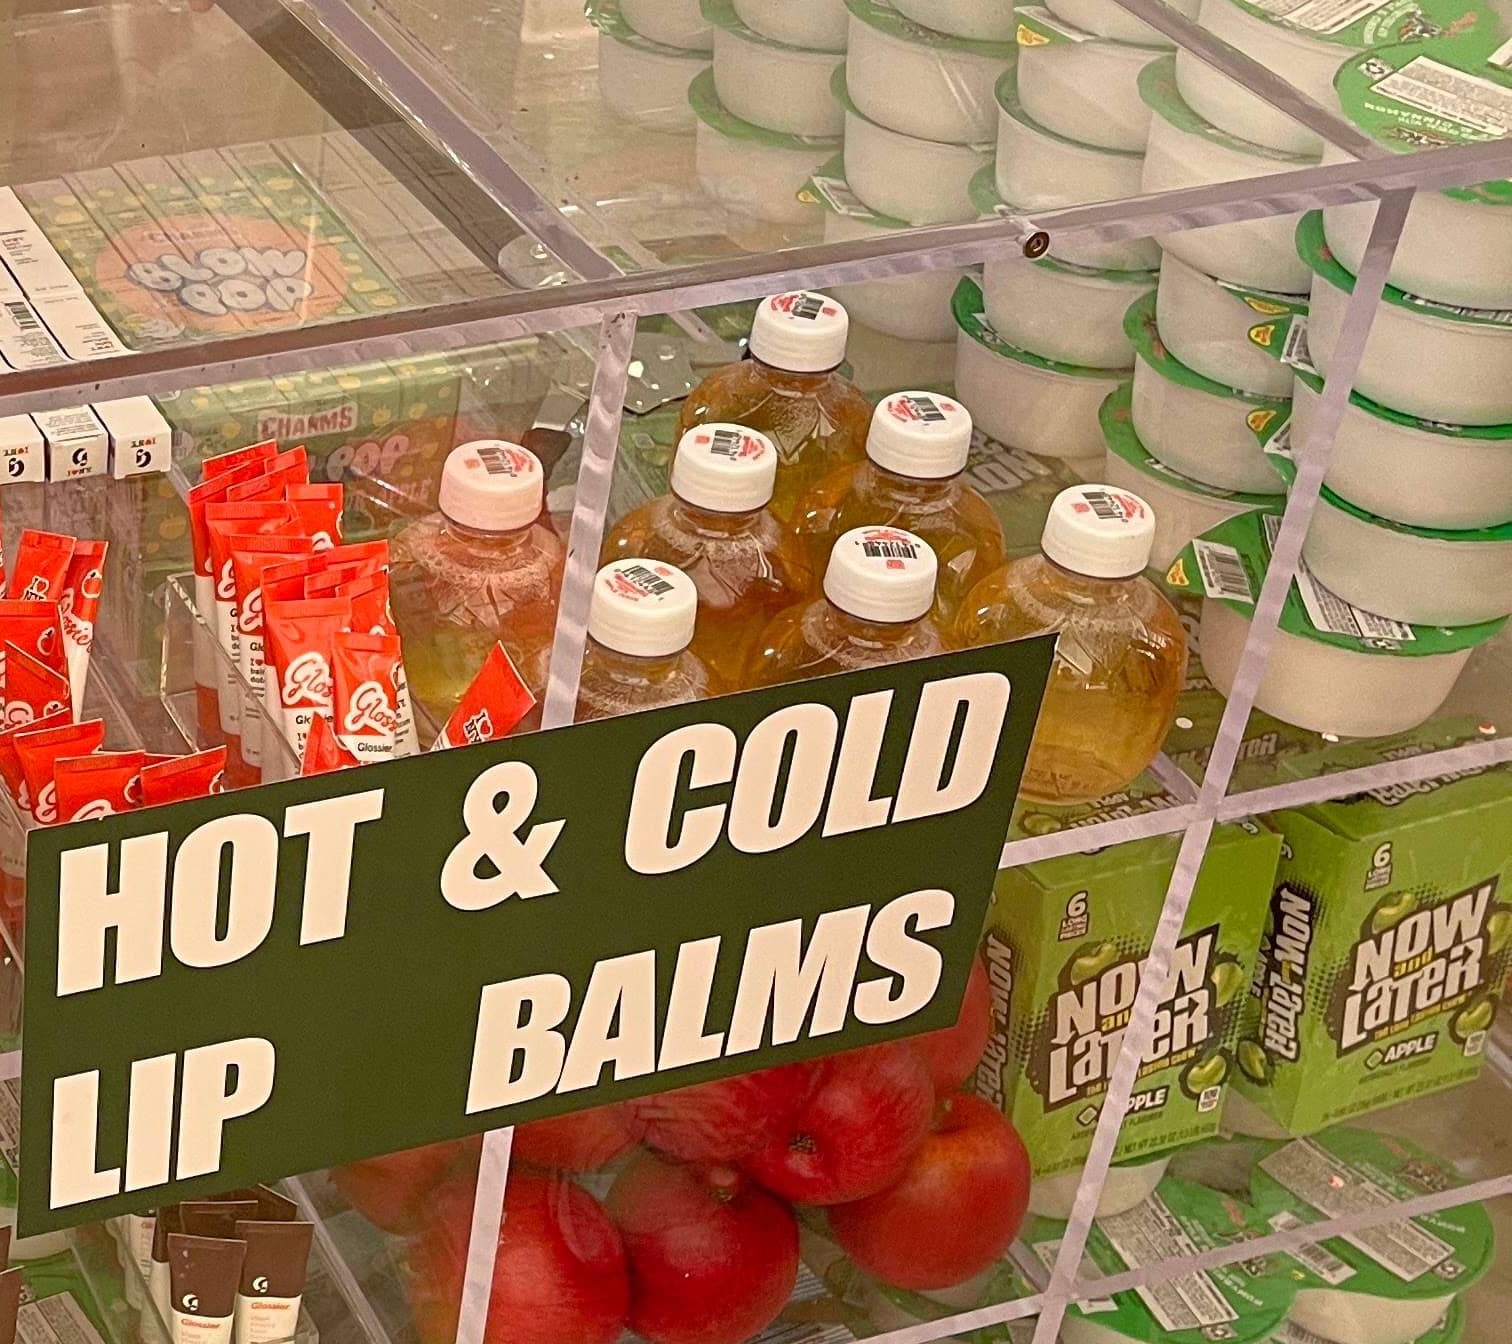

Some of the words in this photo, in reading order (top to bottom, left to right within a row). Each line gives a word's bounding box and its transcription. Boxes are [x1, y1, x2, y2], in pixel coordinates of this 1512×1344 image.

[260, 406, 353, 438] CHARMS
[55, 786, 386, 998] HOT
[439, 759, 567, 913] &
[624, 670, 1012, 876] COLD
[1373, 842, 1392, 869] 6
[1067, 892, 1088, 918] 6
[1347, 884, 1494, 993] NOW
[1393, 946, 1433, 977] and
[1101, 1010, 1131, 1033] an
[48, 1035, 276, 1211] LIP
[464, 887, 957, 1115] BALMS
[1383, 1032, 1438, 1064] APPLE
[1126, 1086, 1169, 1112] PPLE
